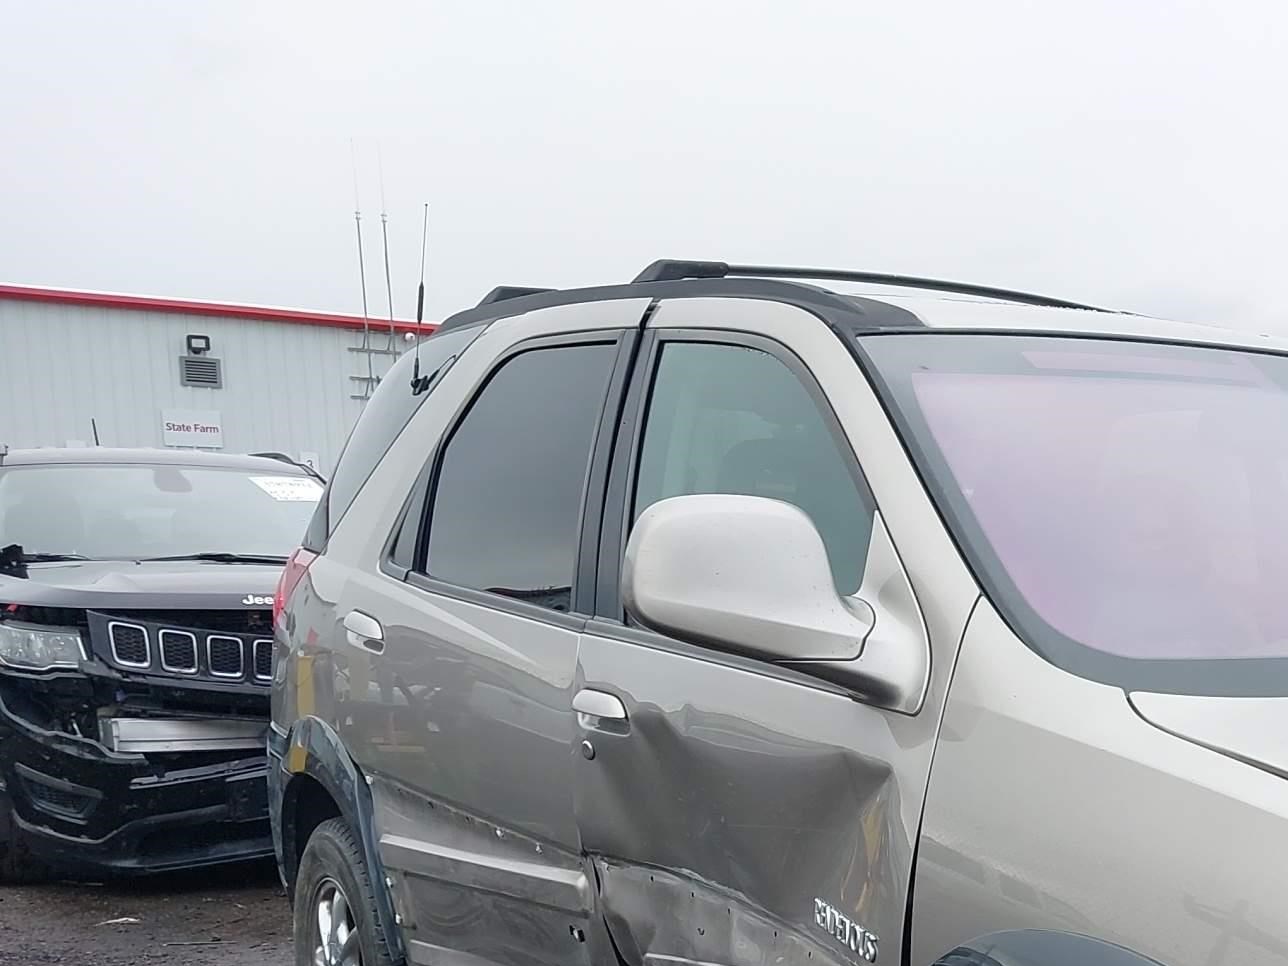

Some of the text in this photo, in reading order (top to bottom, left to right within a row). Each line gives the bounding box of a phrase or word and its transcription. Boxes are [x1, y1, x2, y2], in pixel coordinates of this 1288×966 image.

[165, 422, 219, 434] State Farm
[242, 594, 275, 605] Jee
